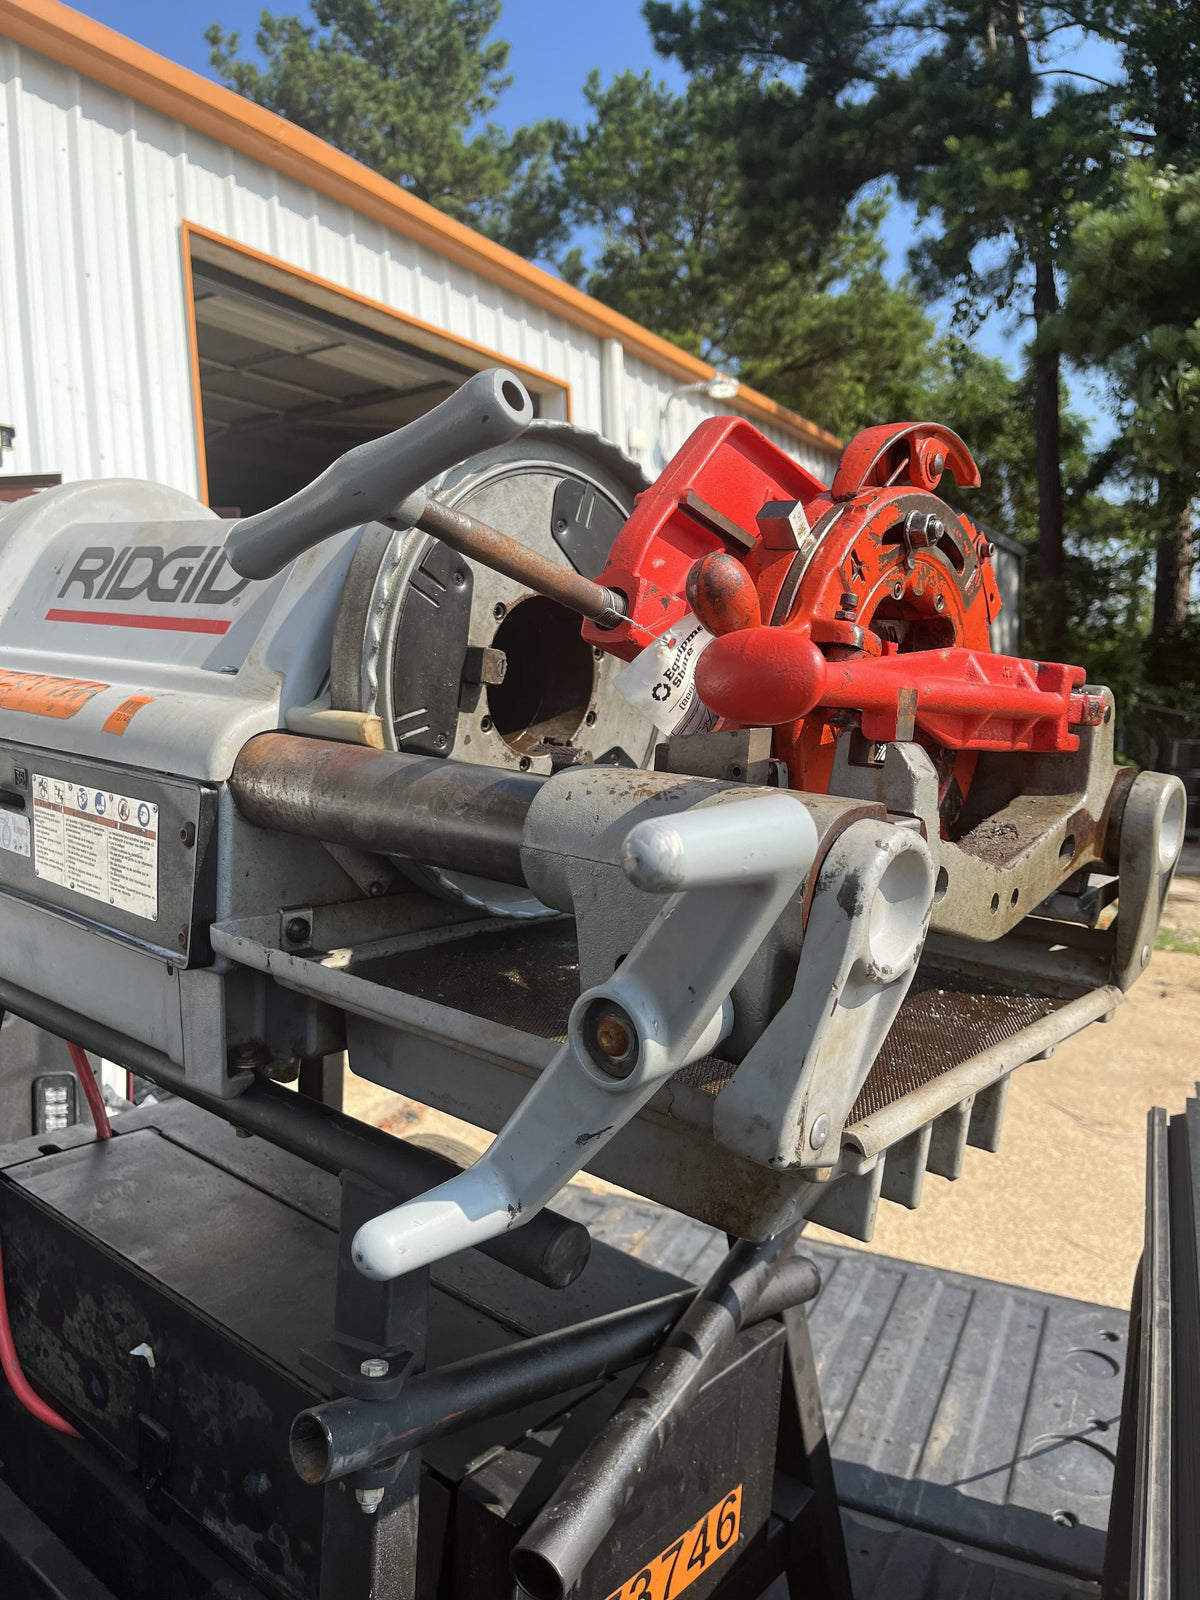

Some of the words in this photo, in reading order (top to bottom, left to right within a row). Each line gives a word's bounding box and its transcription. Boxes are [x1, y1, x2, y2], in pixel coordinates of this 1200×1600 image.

[57, 546, 251, 604] RIDGID
[663, 625, 703, 681] Equipme
[672, 646, 694, 688] Share
[605, 1493, 737, 1600] 3746
